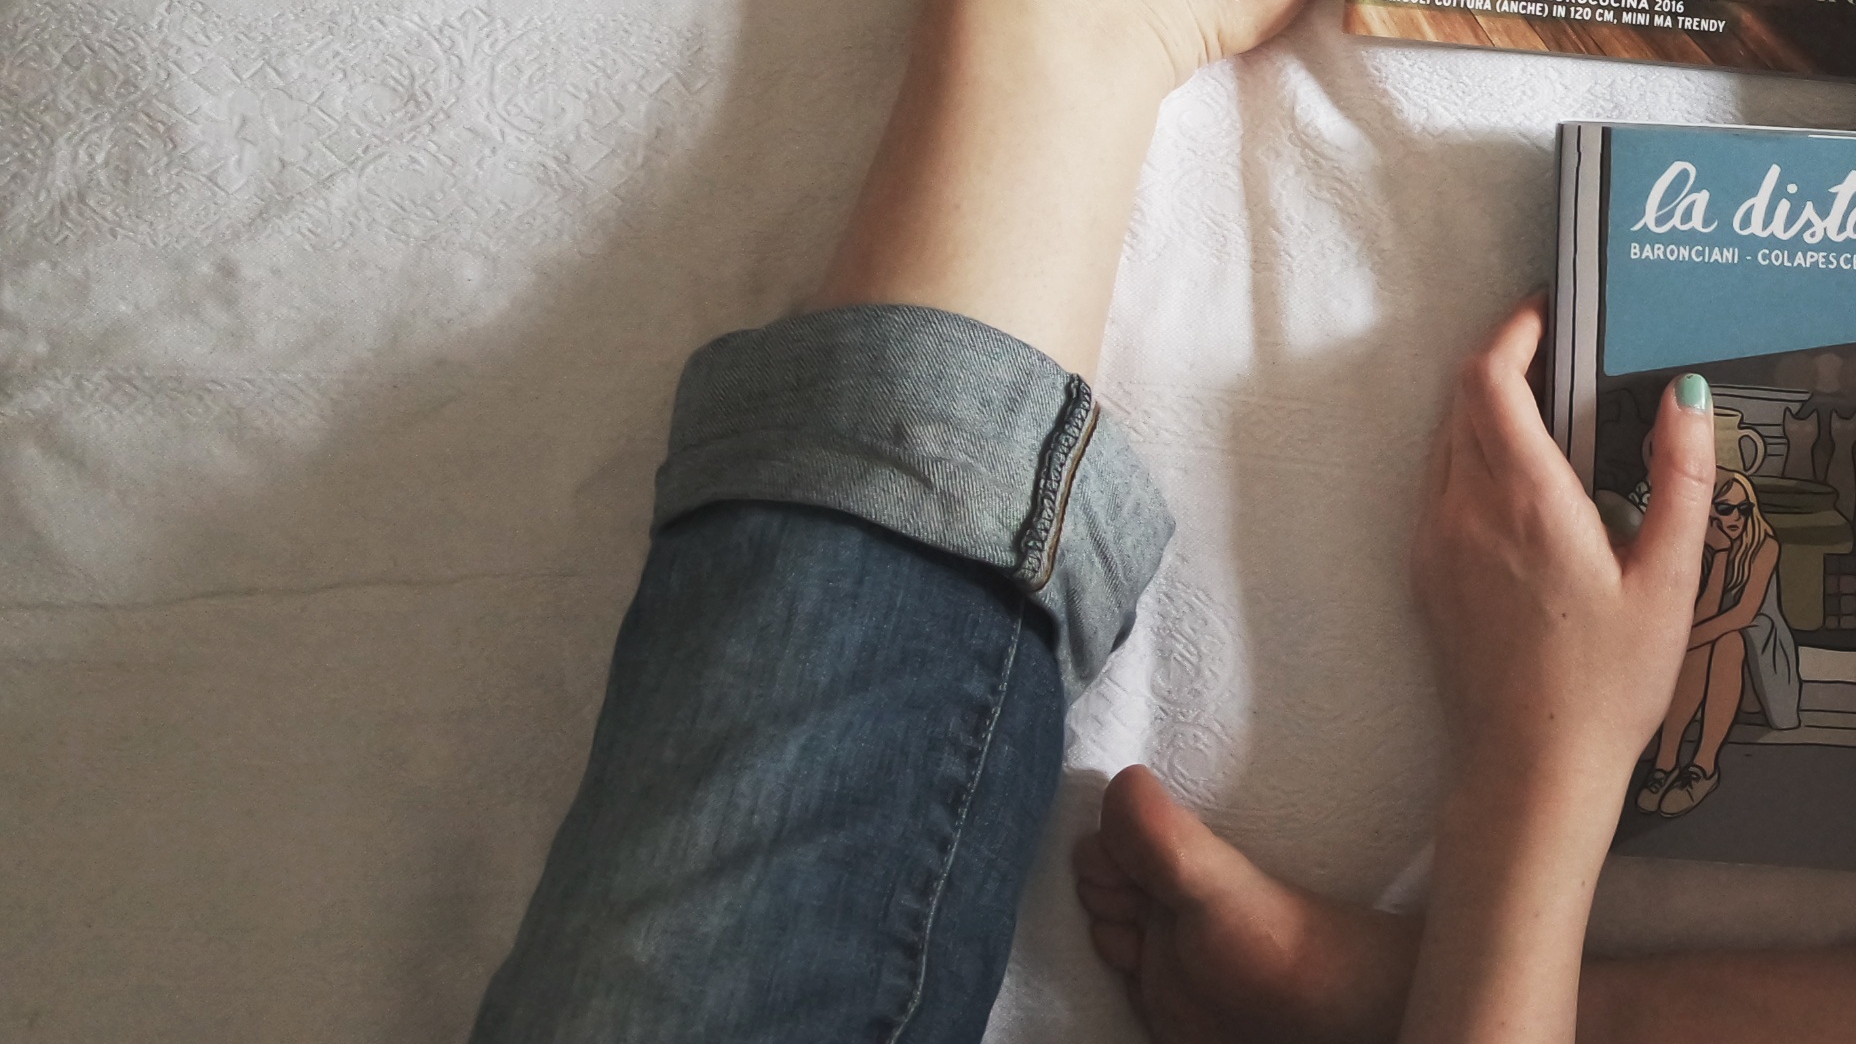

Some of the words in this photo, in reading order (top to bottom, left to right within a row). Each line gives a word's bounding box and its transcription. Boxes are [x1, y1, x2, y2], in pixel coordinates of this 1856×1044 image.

[1496, 0, 1548, 17] (ANCHE)
[1570, 7, 1591, 20] 120
[1595, 9, 1617, 24] CM,
[1622, 11, 1649, 25] MINI
[1678, 16, 1726, 33] TRENDY
[1655, 0, 1685, 13] 2016
[1631, 161, 1718, 234] la
[1630, 242, 1739, 264] BARONCIANI
